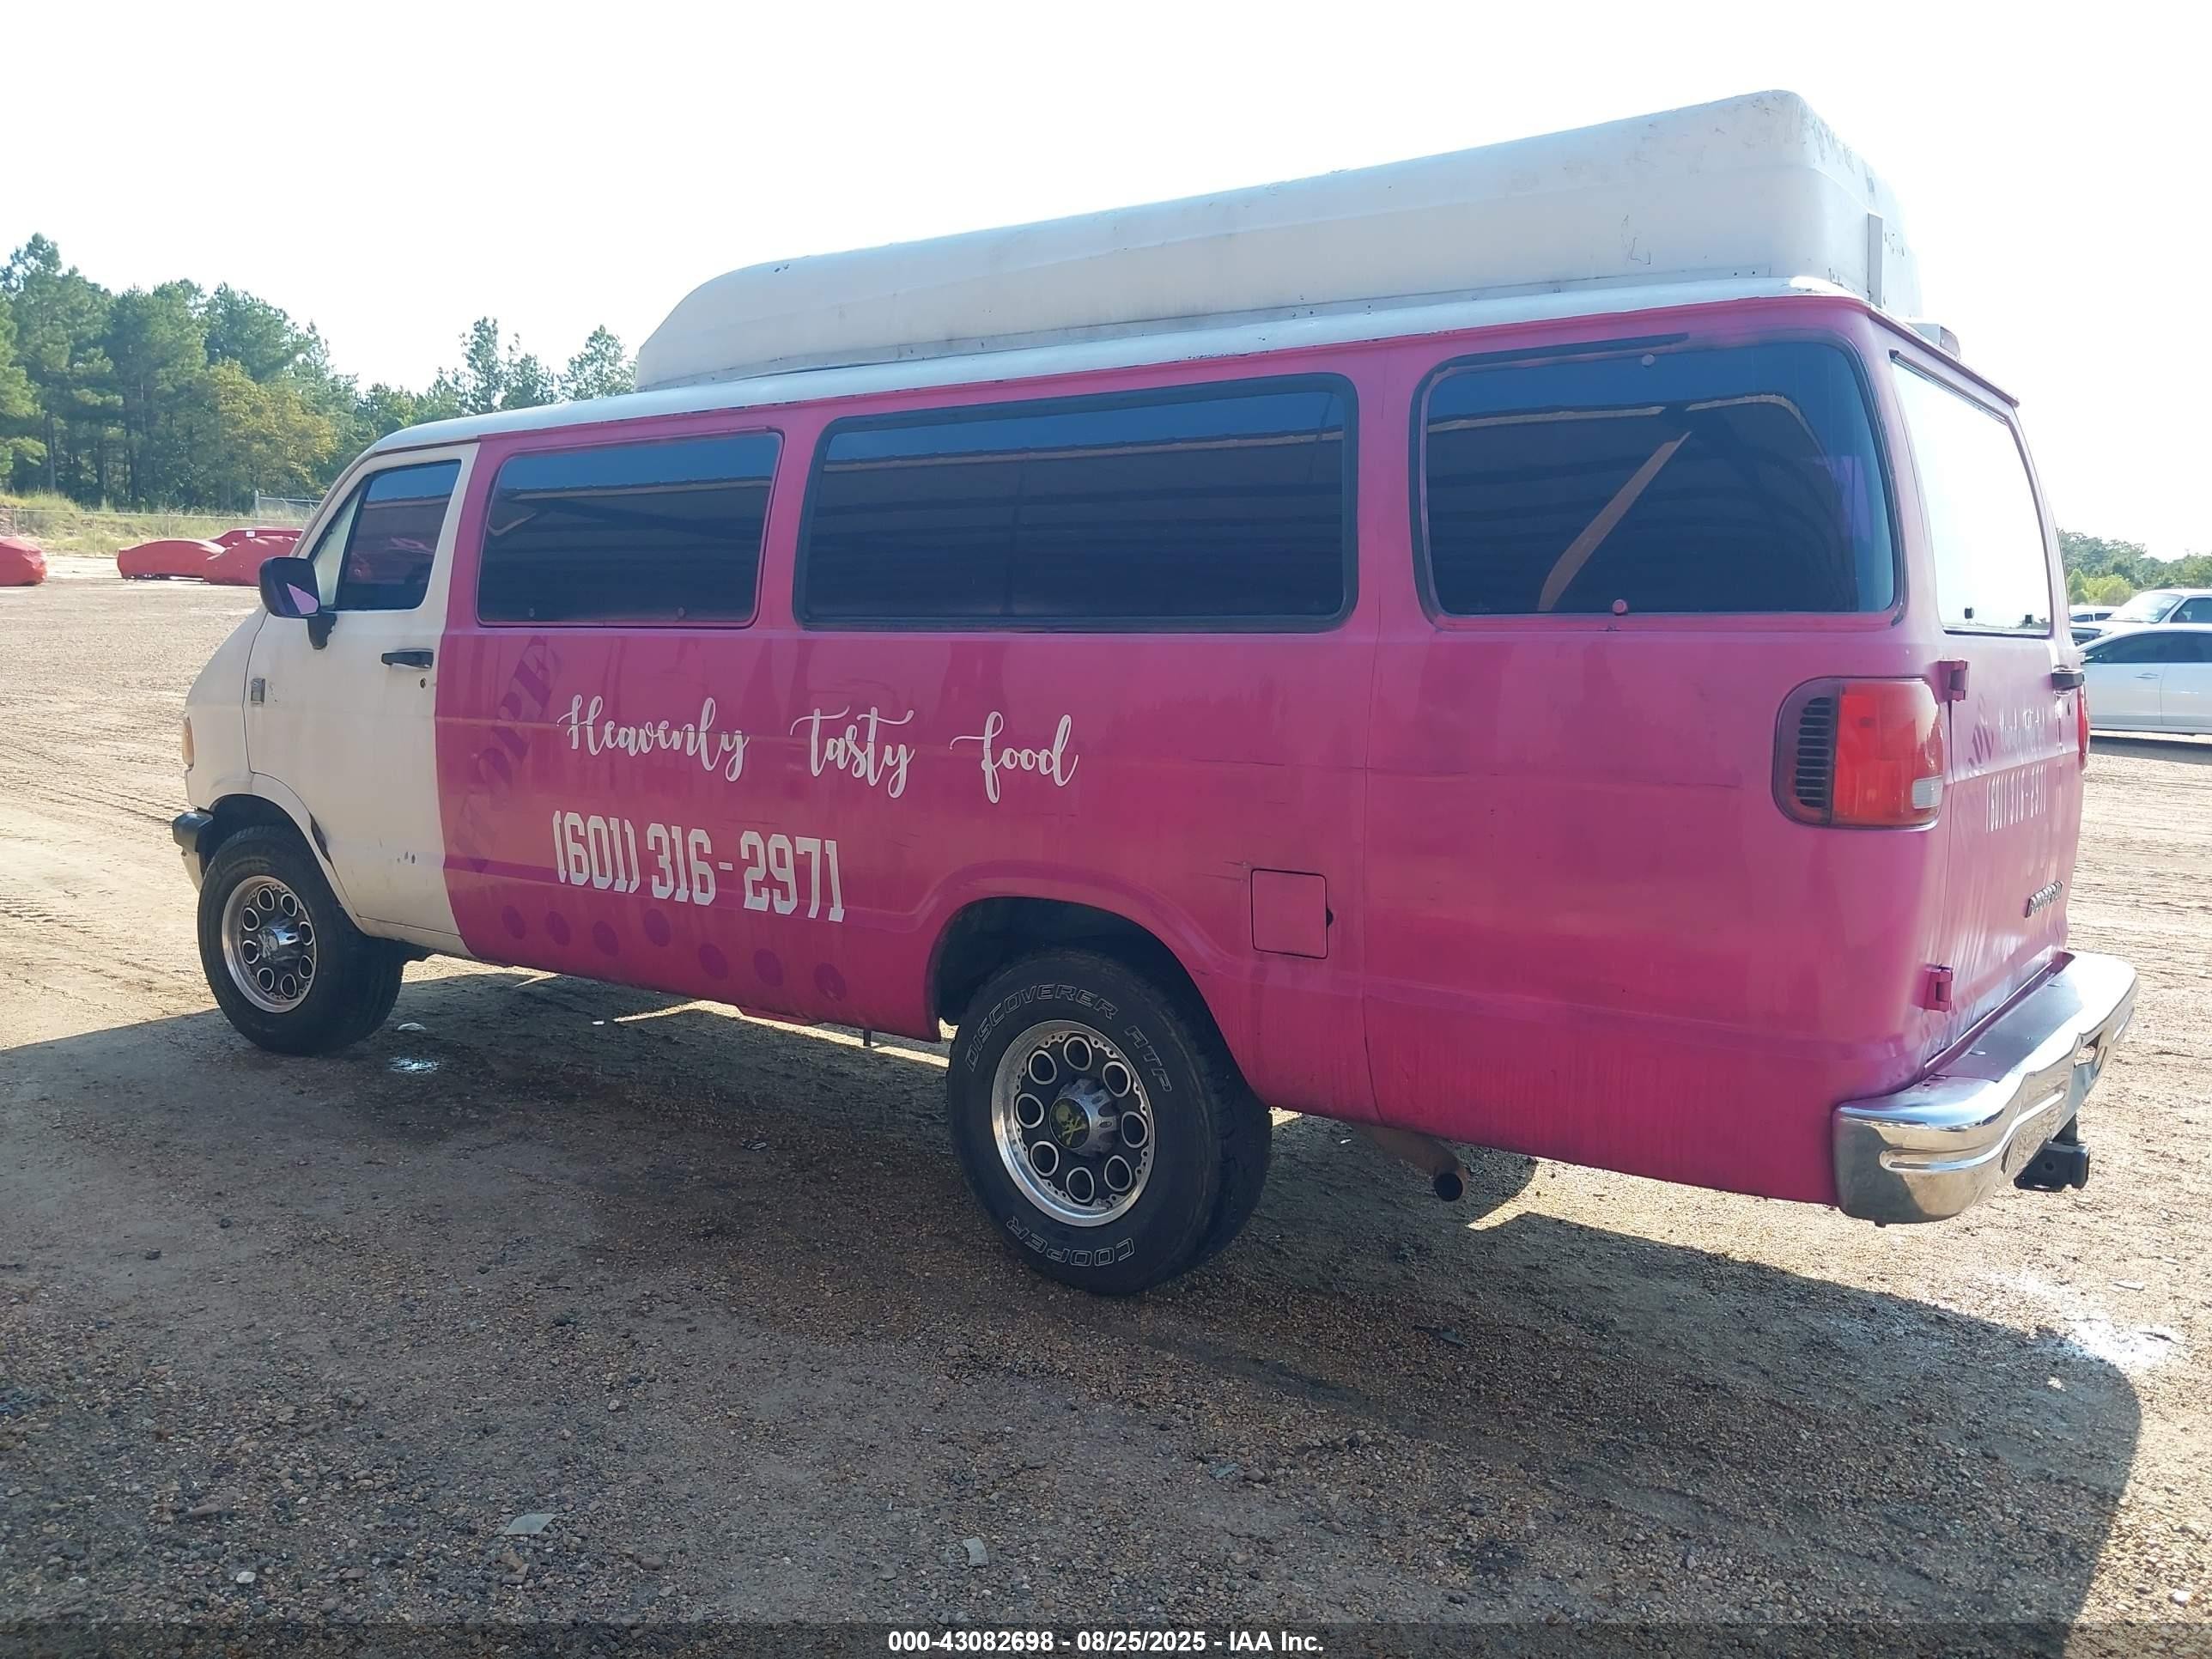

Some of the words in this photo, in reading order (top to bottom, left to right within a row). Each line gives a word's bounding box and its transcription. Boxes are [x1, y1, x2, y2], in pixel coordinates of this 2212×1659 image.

[556, 694, 750, 781] Heavenly
[790, 706, 915, 799] tasty
[949, 711, 1079, 804] food
[552, 810, 641, 894] (601)
[965, 983, 1119, 1073] DISCOVERER
[1123, 1025, 1173, 1092] ATP
[1006, 1216, 1135, 1267] COOPER
